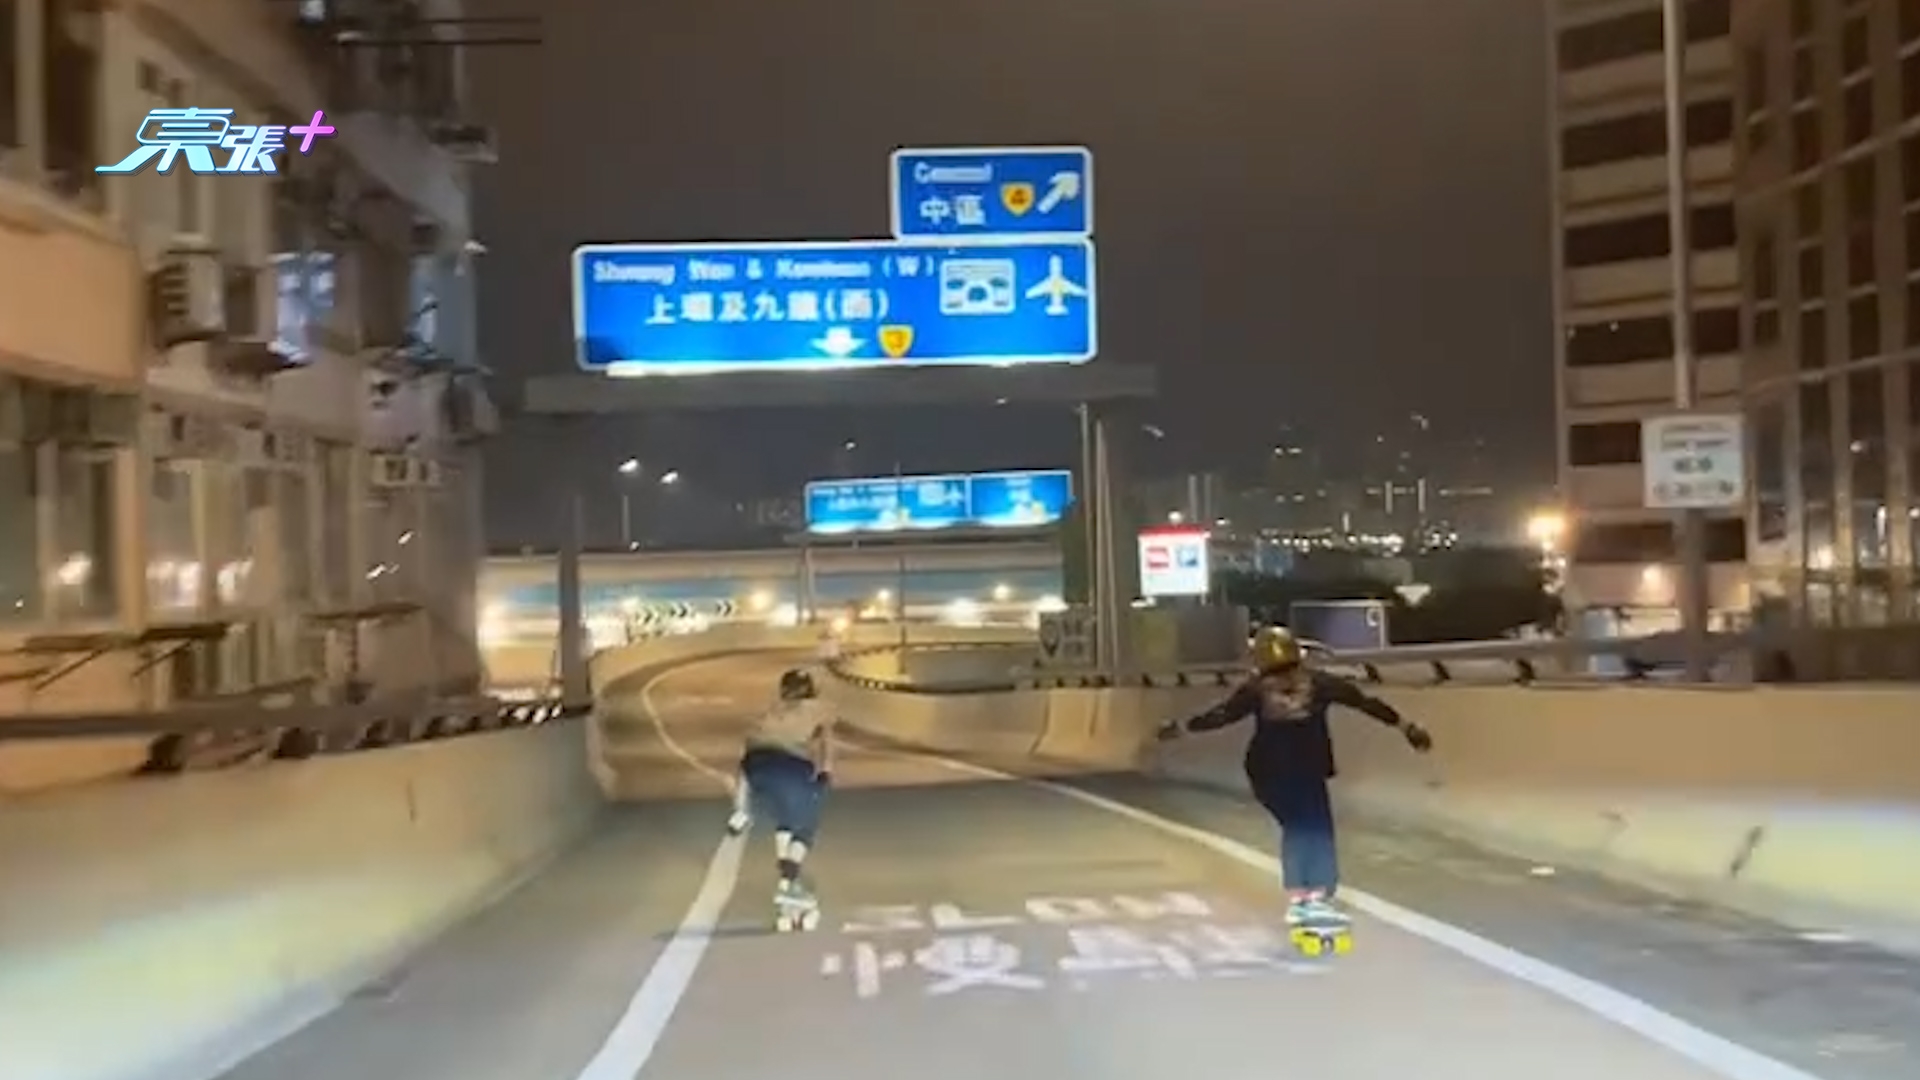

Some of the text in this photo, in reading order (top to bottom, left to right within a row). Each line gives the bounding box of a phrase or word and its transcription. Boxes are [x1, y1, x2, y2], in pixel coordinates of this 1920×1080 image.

[592, 259, 676, 286] Shg
[644, 287, 890, 325] 上及九(西)
